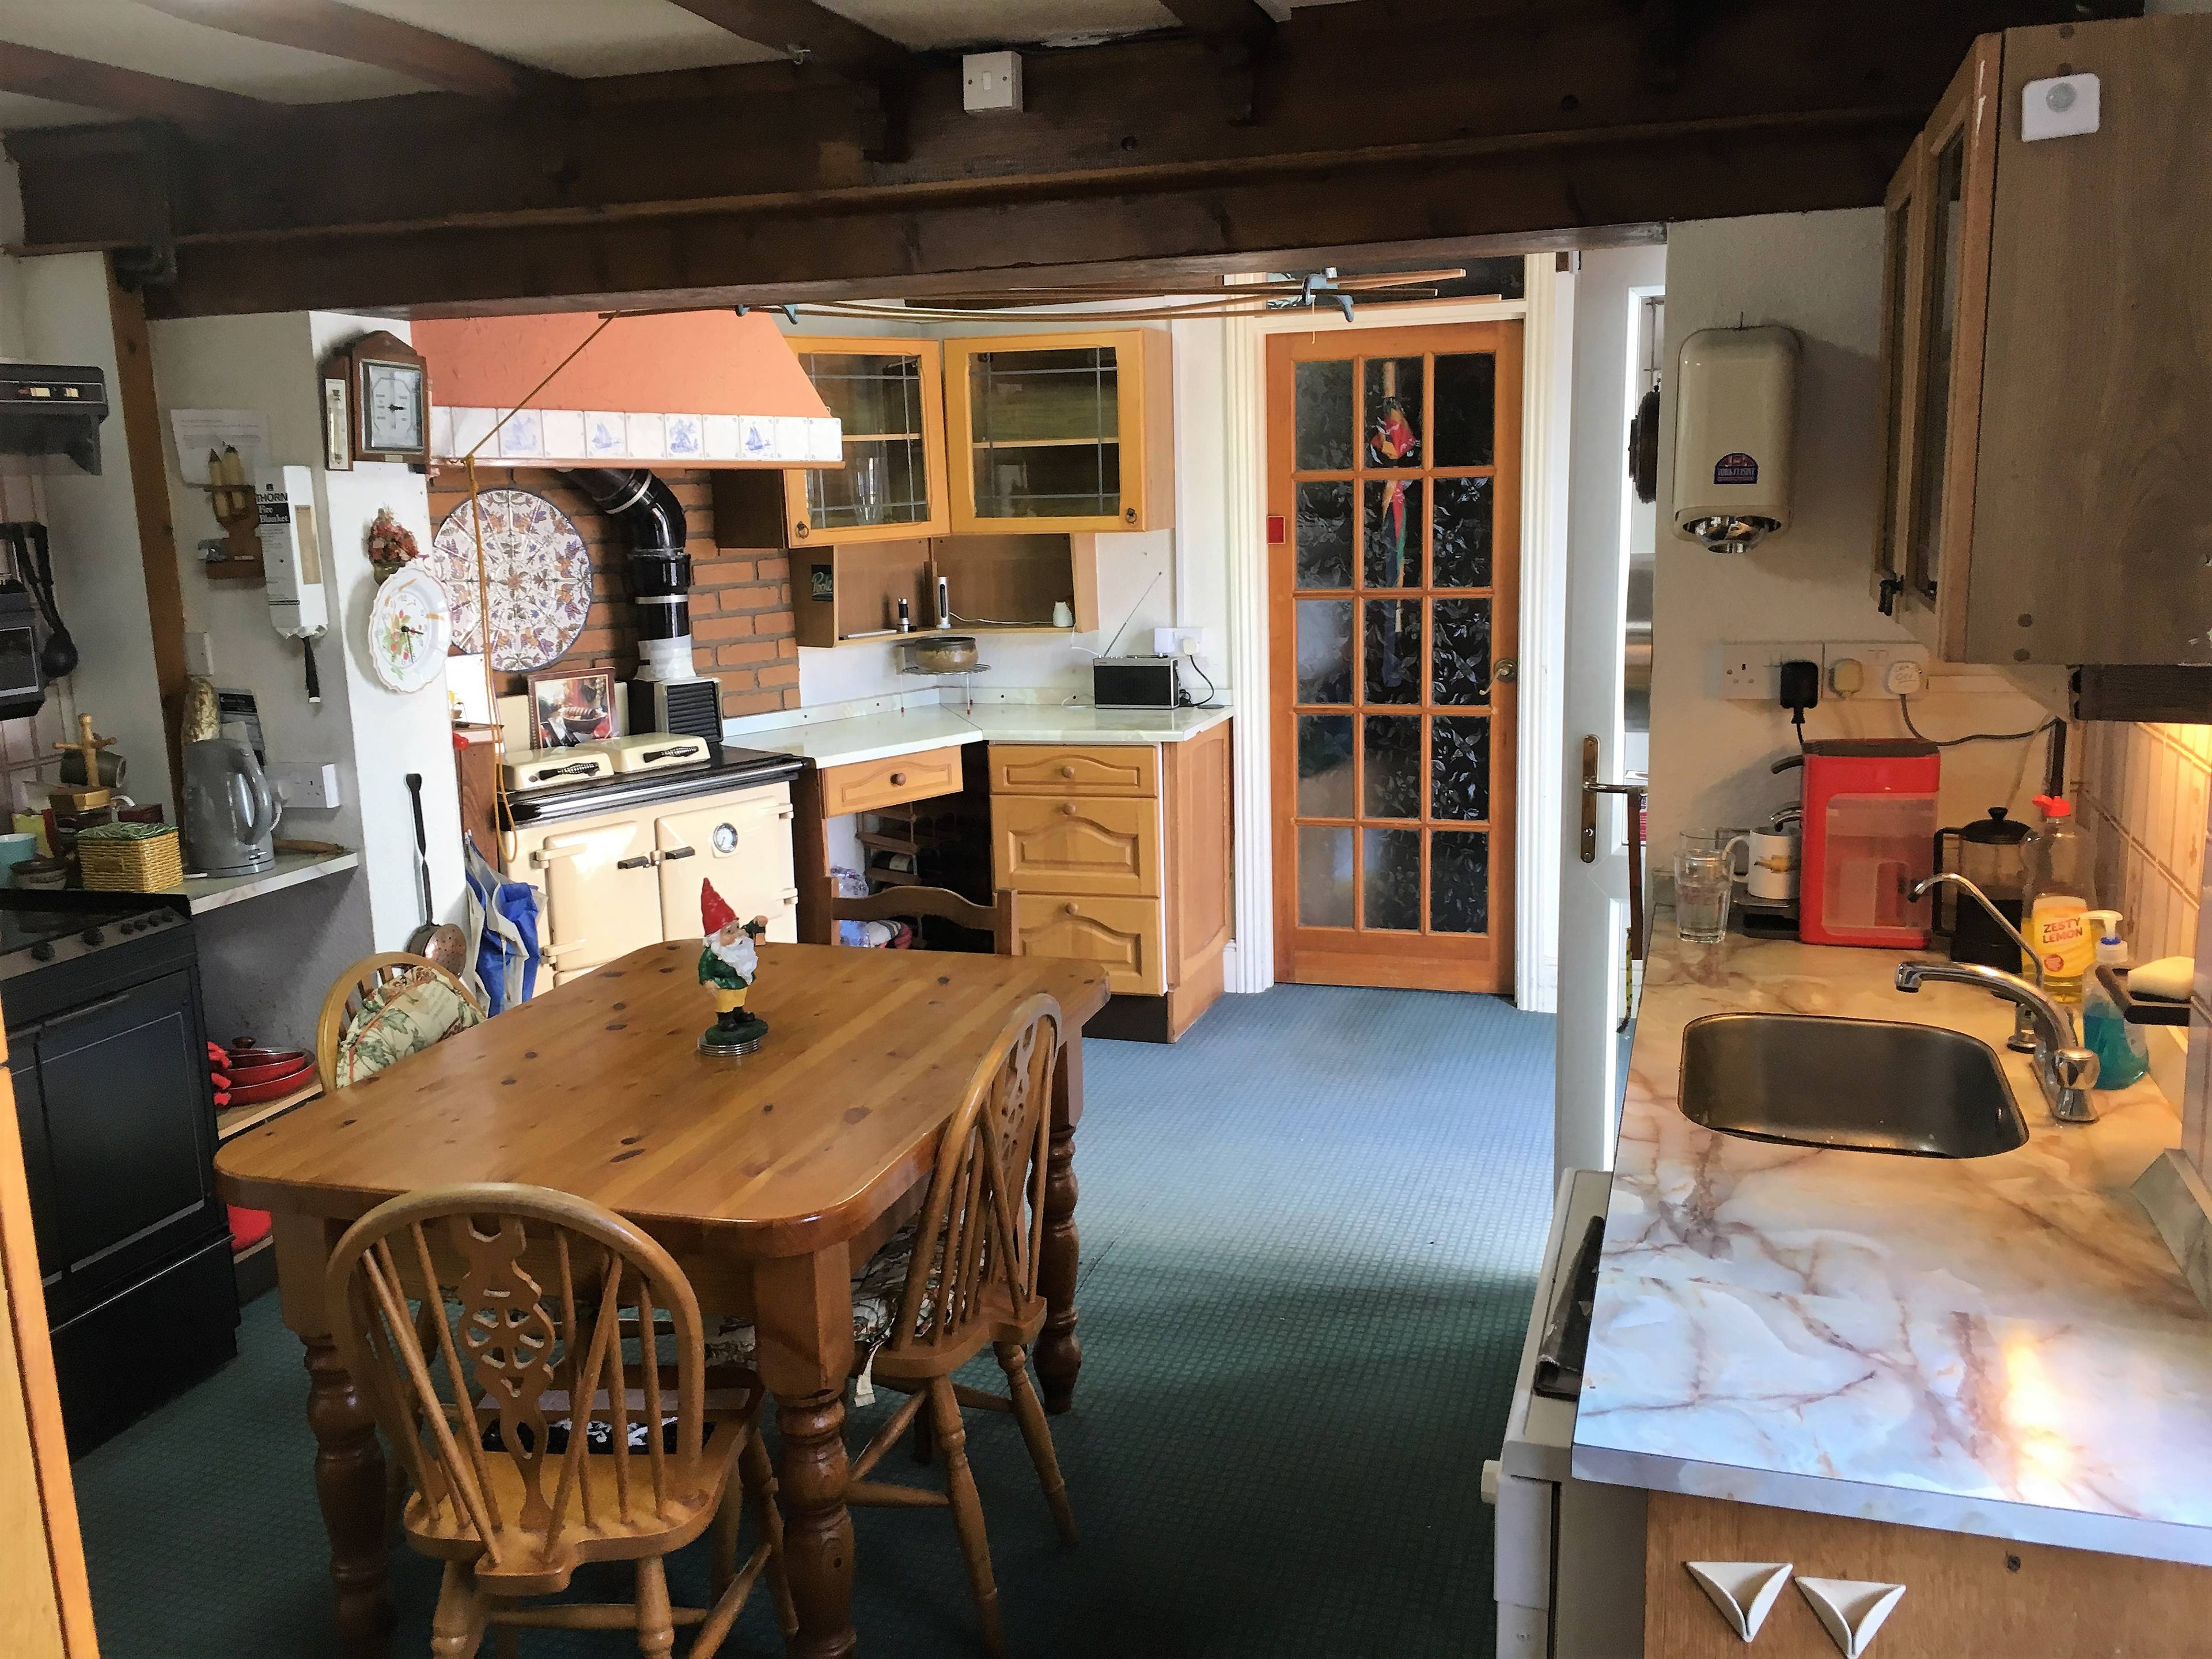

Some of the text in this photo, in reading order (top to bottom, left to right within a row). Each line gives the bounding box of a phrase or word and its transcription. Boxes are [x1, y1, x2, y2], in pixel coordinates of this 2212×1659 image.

[256, 493, 287, 501] THORN
[2043, 917, 2081, 933] ZESTY
[2043, 927, 2082, 943] LEMON
